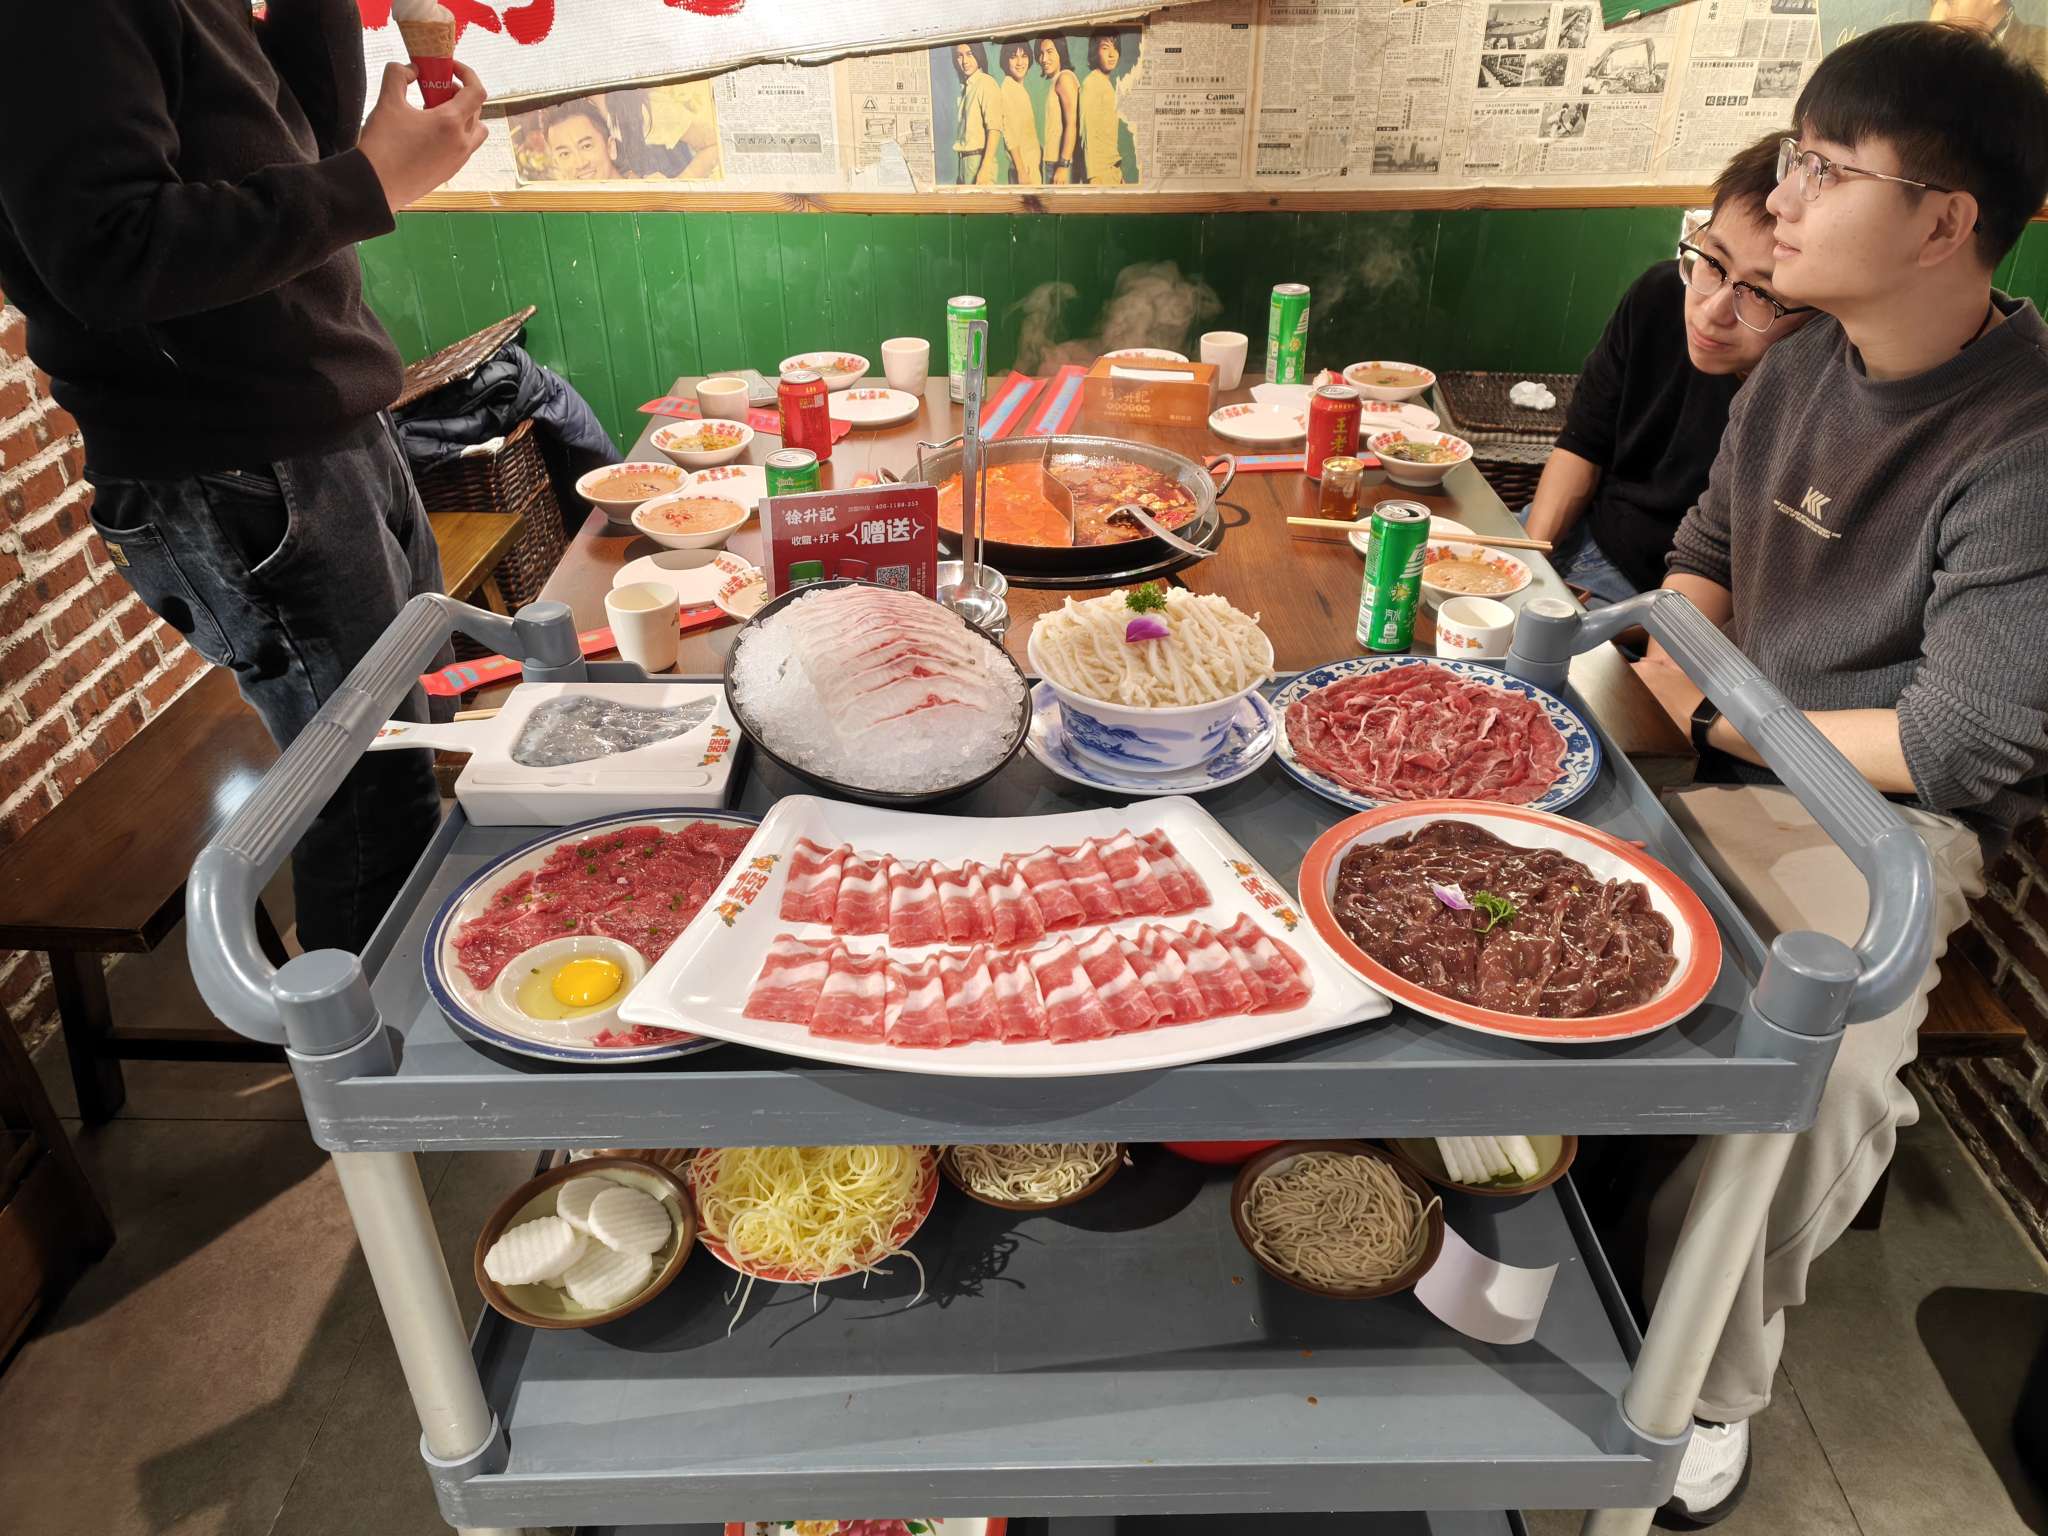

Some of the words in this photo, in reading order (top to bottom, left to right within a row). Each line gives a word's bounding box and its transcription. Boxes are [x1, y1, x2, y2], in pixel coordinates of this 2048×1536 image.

[1205, 93, 1235, 101] Canon
[1329, 416, 1349, 456] 王老
[784, 506, 837, 526] 徐升記
[860, 517, 911, 545] 赠送
